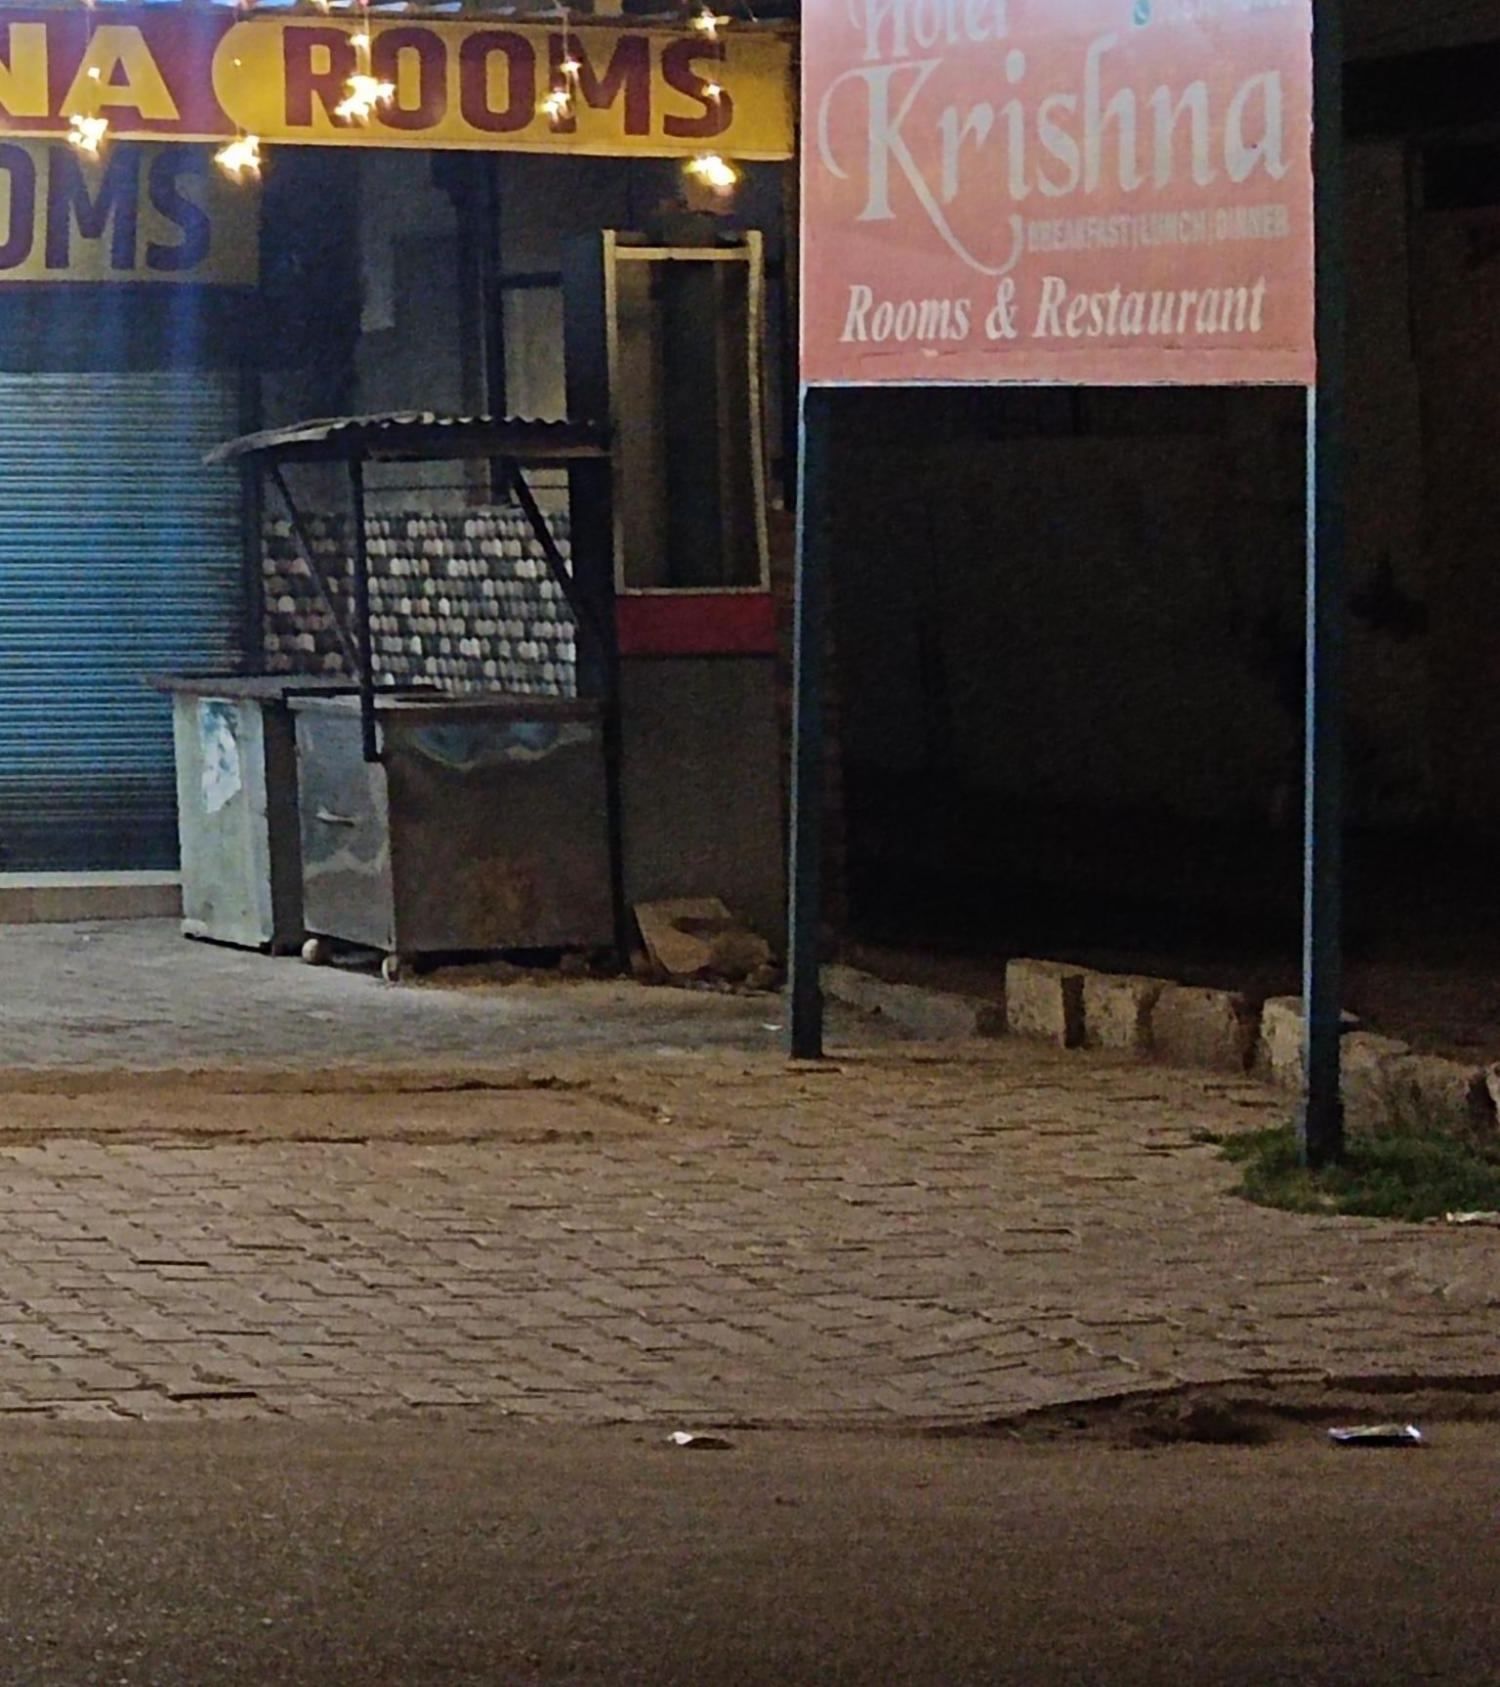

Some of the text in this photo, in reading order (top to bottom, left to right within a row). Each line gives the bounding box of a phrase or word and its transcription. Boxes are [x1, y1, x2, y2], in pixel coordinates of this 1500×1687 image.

[283, 26, 734, 139] ROOMS
[818, 32, 1294, 276] Krishna
[840, 275, 1267, 344] Rooms & Restaurant
